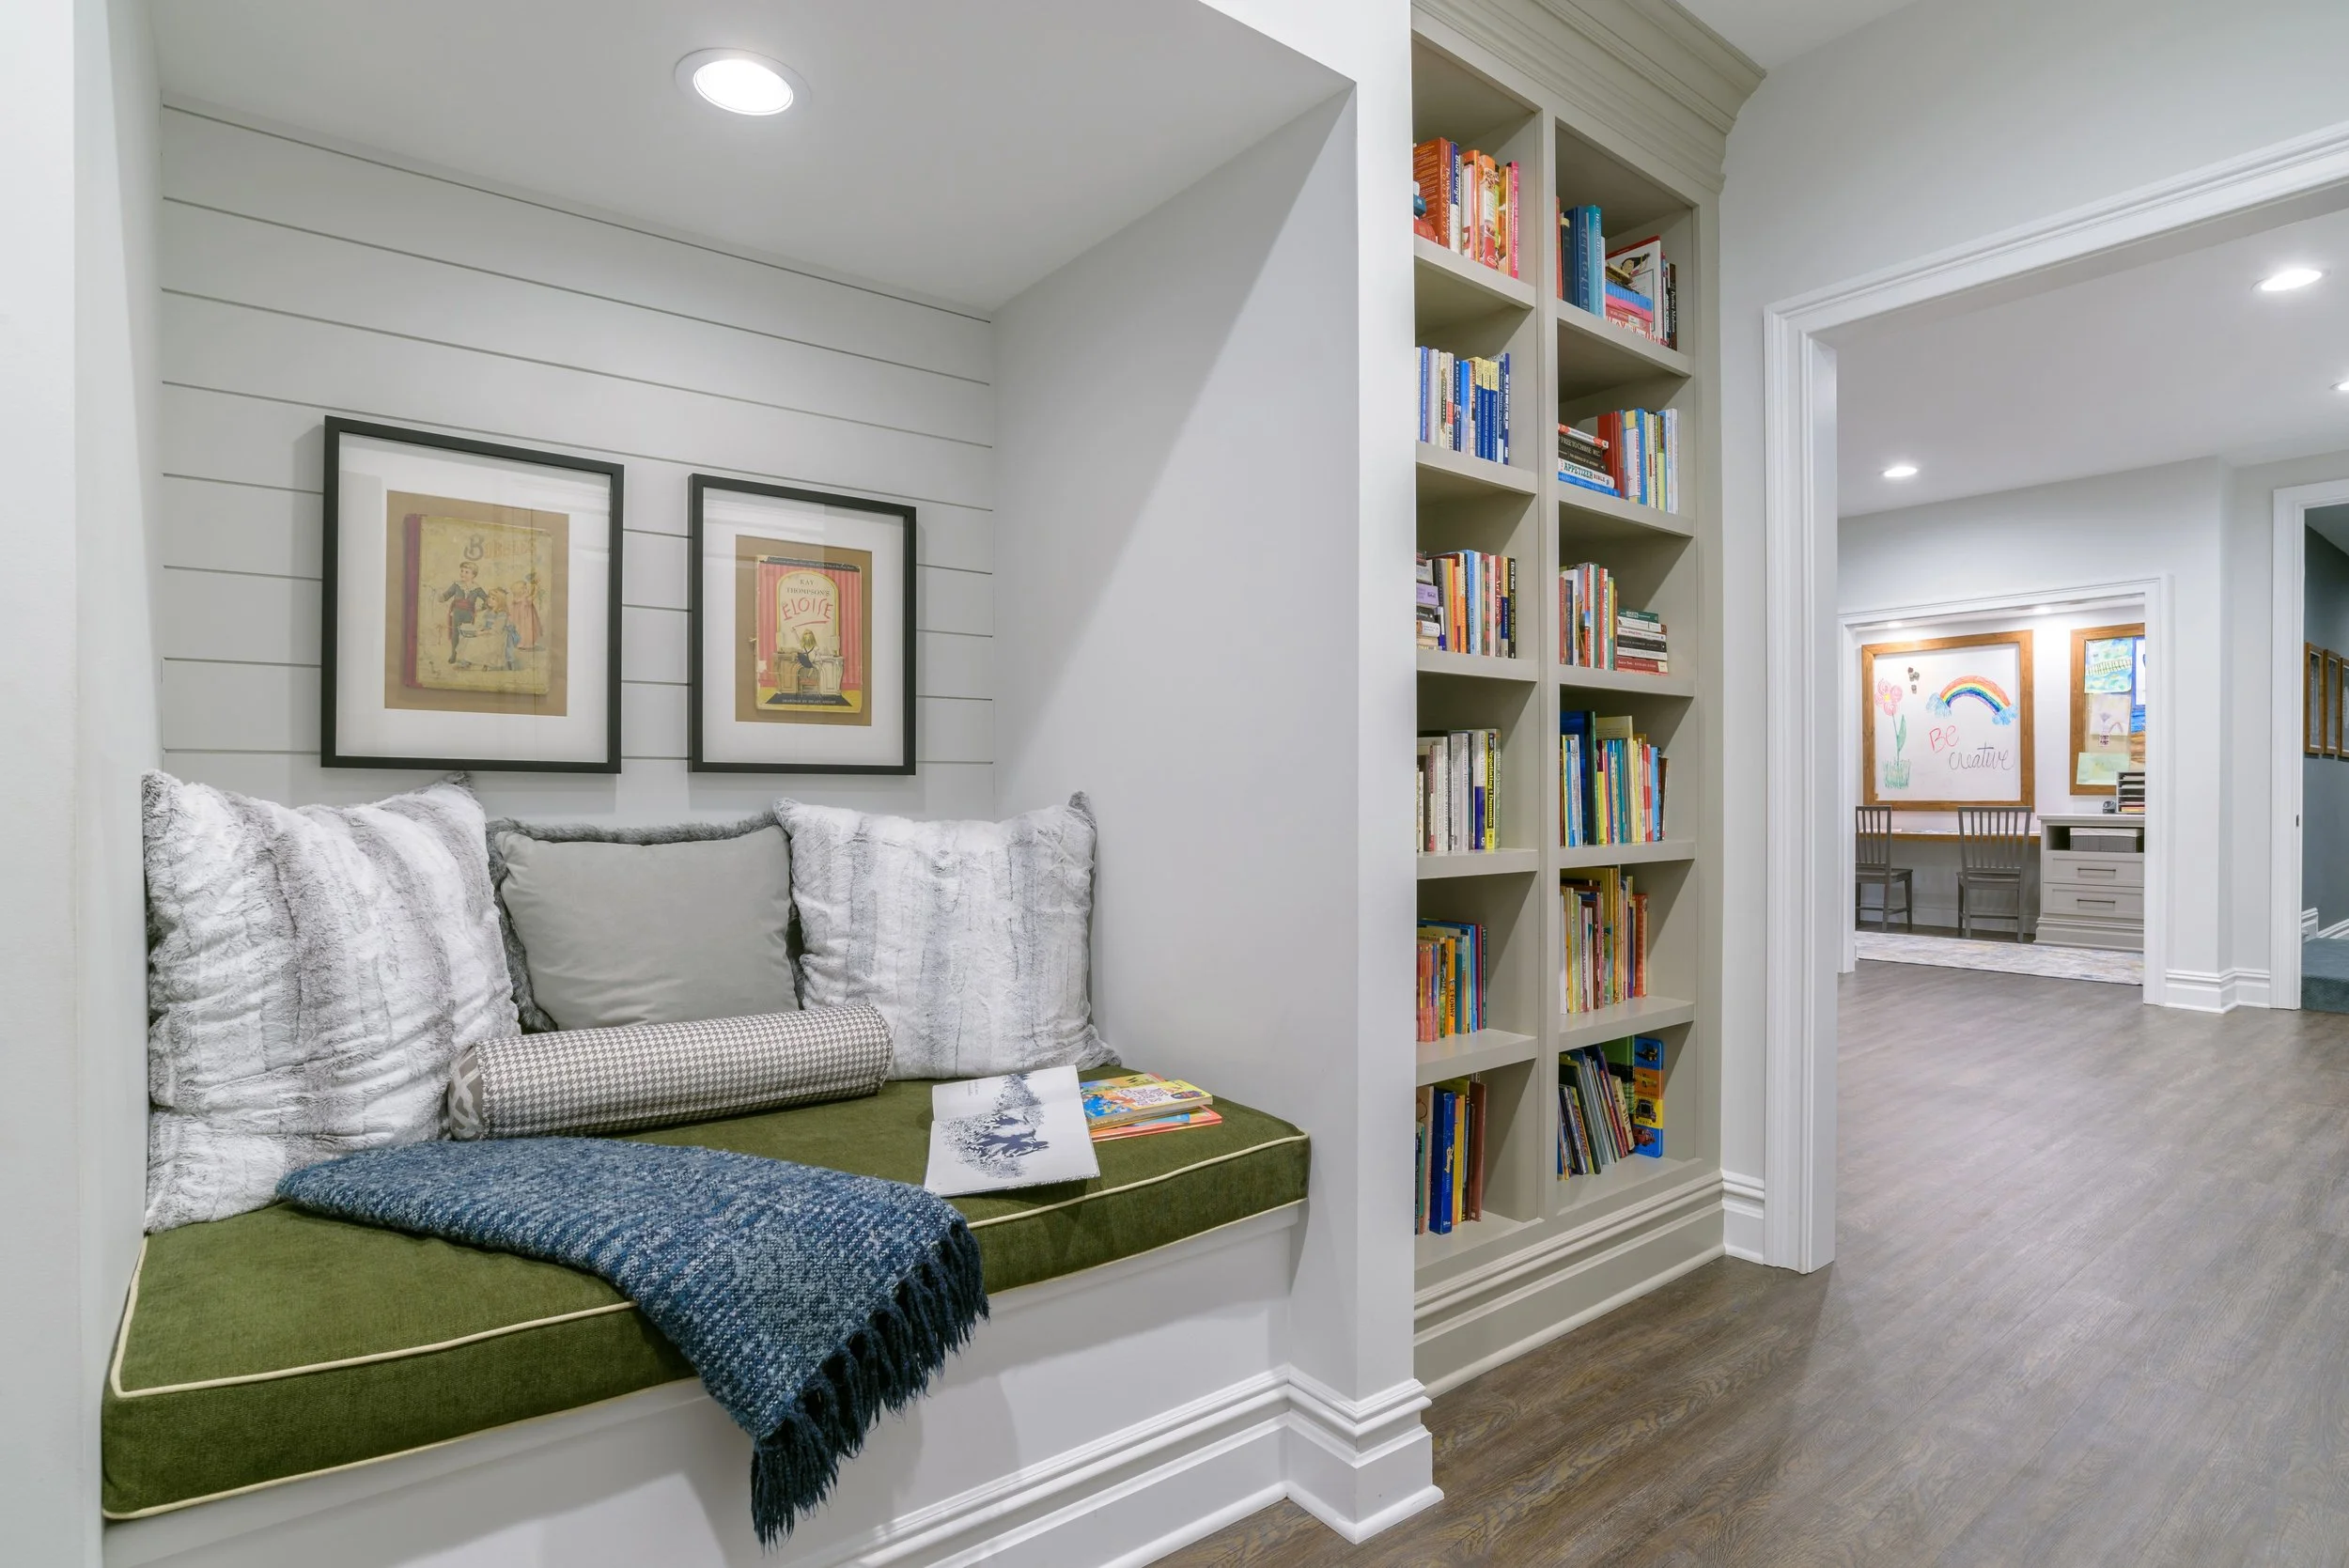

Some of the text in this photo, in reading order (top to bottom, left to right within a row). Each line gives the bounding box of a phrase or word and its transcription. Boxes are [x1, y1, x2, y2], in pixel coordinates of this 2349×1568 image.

[786, 587, 830, 597] THOMPSON'S
[782, 597, 833, 621] ELOISE
[1443, 1143, 1455, 1172] Disney
